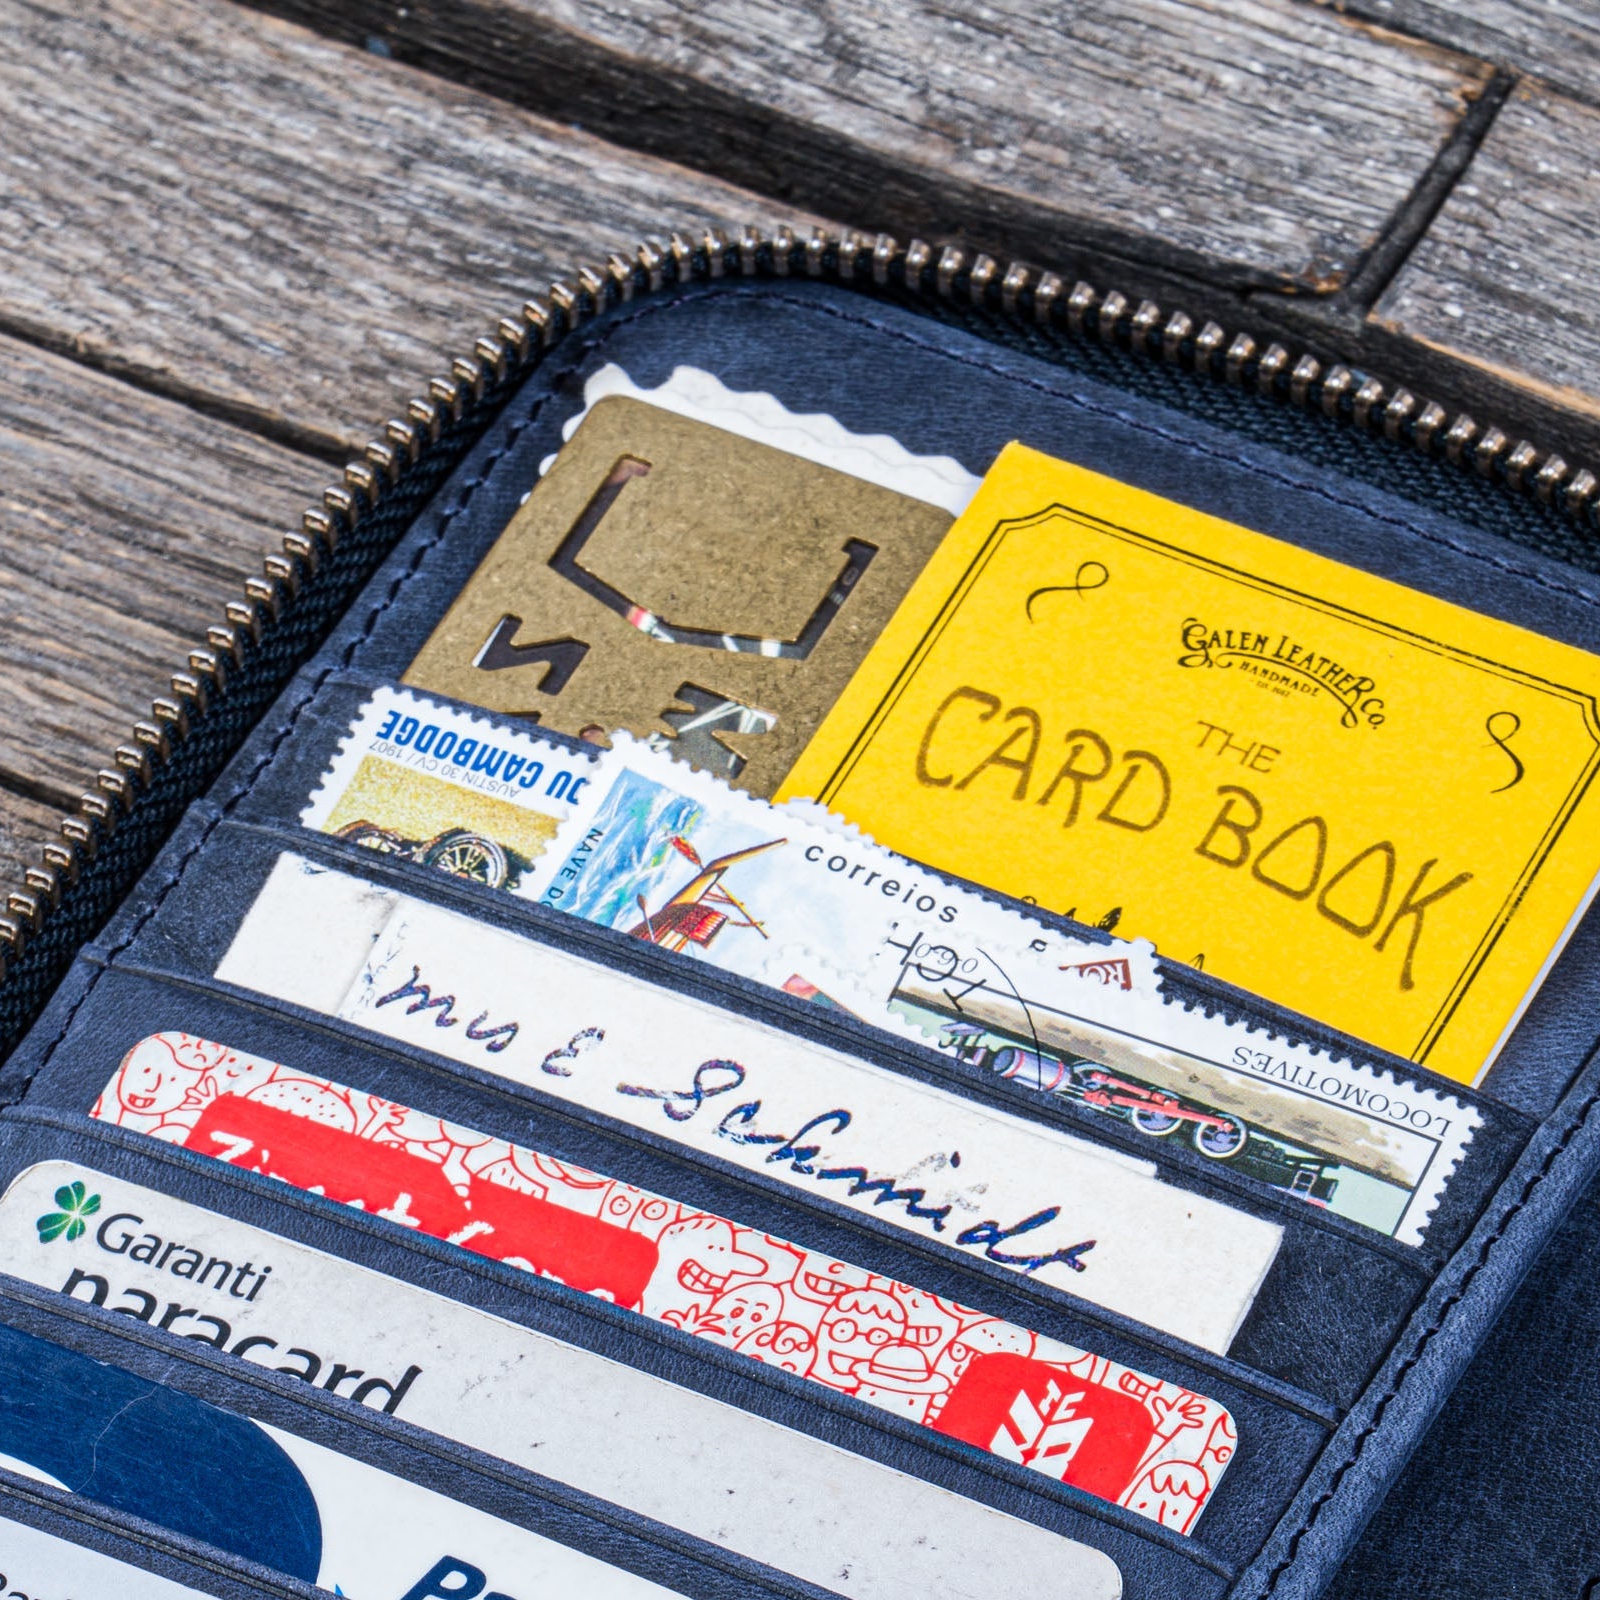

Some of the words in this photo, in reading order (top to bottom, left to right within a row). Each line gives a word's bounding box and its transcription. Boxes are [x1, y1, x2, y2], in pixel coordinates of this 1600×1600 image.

[1177, 617, 1269, 668] GALEN
[1239, 660, 1321, 698] HANDMADE
[368, 740, 403, 761] 1907
[376, 709, 544, 789] CAMBODGE
[441, 765, 458, 780] 30
[1197, 720, 1282, 775] THE
[461, 769, 521, 799] AUSTIN
[560, 828, 604, 881] NAVE
[914, 685, 1172, 835] CARD
[1194, 785, 1474, 992] BOOK
[804, 844, 959, 924] correios
[1231, 1045, 1453, 1138] LOCOMOTIVES
[95, 1211, 274, 1303] Garanti
